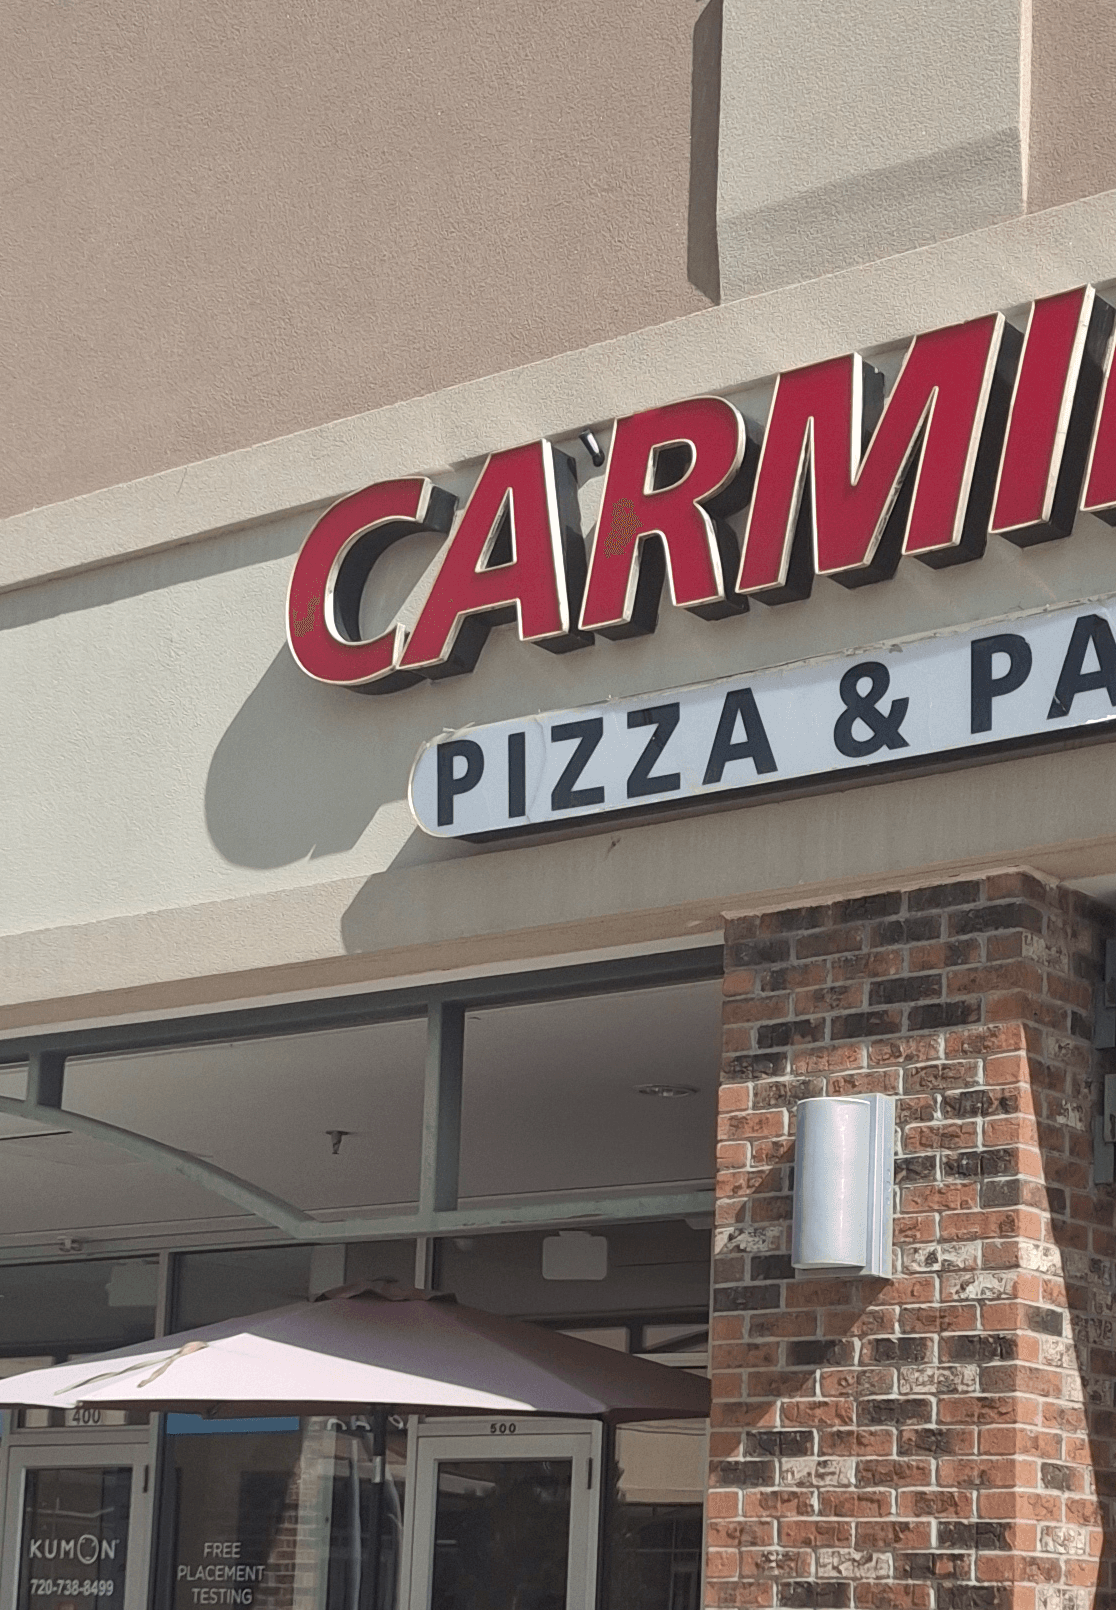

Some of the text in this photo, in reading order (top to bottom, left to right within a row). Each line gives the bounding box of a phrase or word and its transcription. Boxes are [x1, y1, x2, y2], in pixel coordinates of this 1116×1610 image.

[436, 684, 778, 827] PIZZA
[833, 661, 909, 757] &
[72, 1409, 100, 1424] 400
[490, 1423, 516, 1434] 500
[29, 1534, 117, 1564] KUMON
[203, 1542, 242, 1558] FREE
[177, 1565, 266, 1581] PLACEMENT
[30, 1579, 114, 1596] 720-738-8499
[191, 1588, 253, 1605] TESTING
